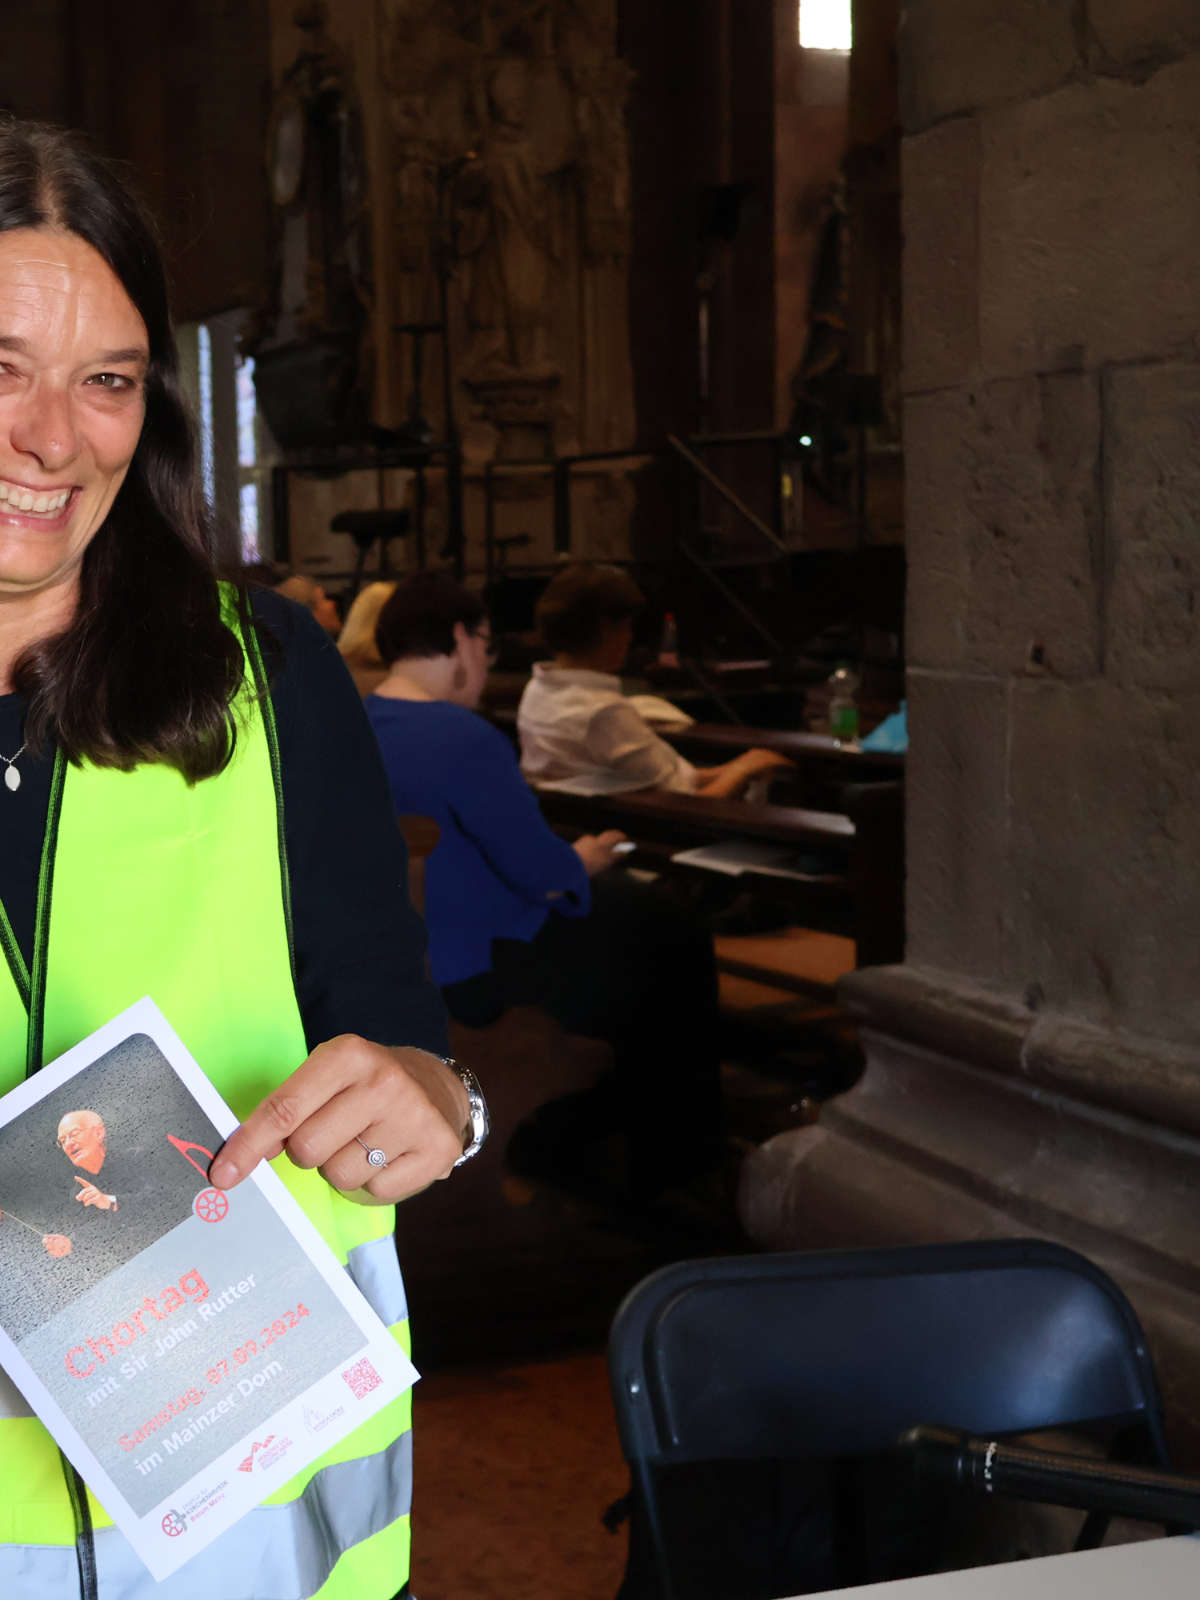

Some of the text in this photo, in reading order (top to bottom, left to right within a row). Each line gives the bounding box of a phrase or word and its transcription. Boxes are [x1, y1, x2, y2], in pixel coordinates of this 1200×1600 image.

[64, 1268, 210, 1379] Chortag
[86, 1273, 257, 1407] mit Sir John Rutter
[118, 1302, 311, 1452] Samstag, 07.09.2024
[134, 1449, 163, 1475] im
[161, 1394, 237, 1455] Mainzer
[236, 1359, 283, 1398] Dom
